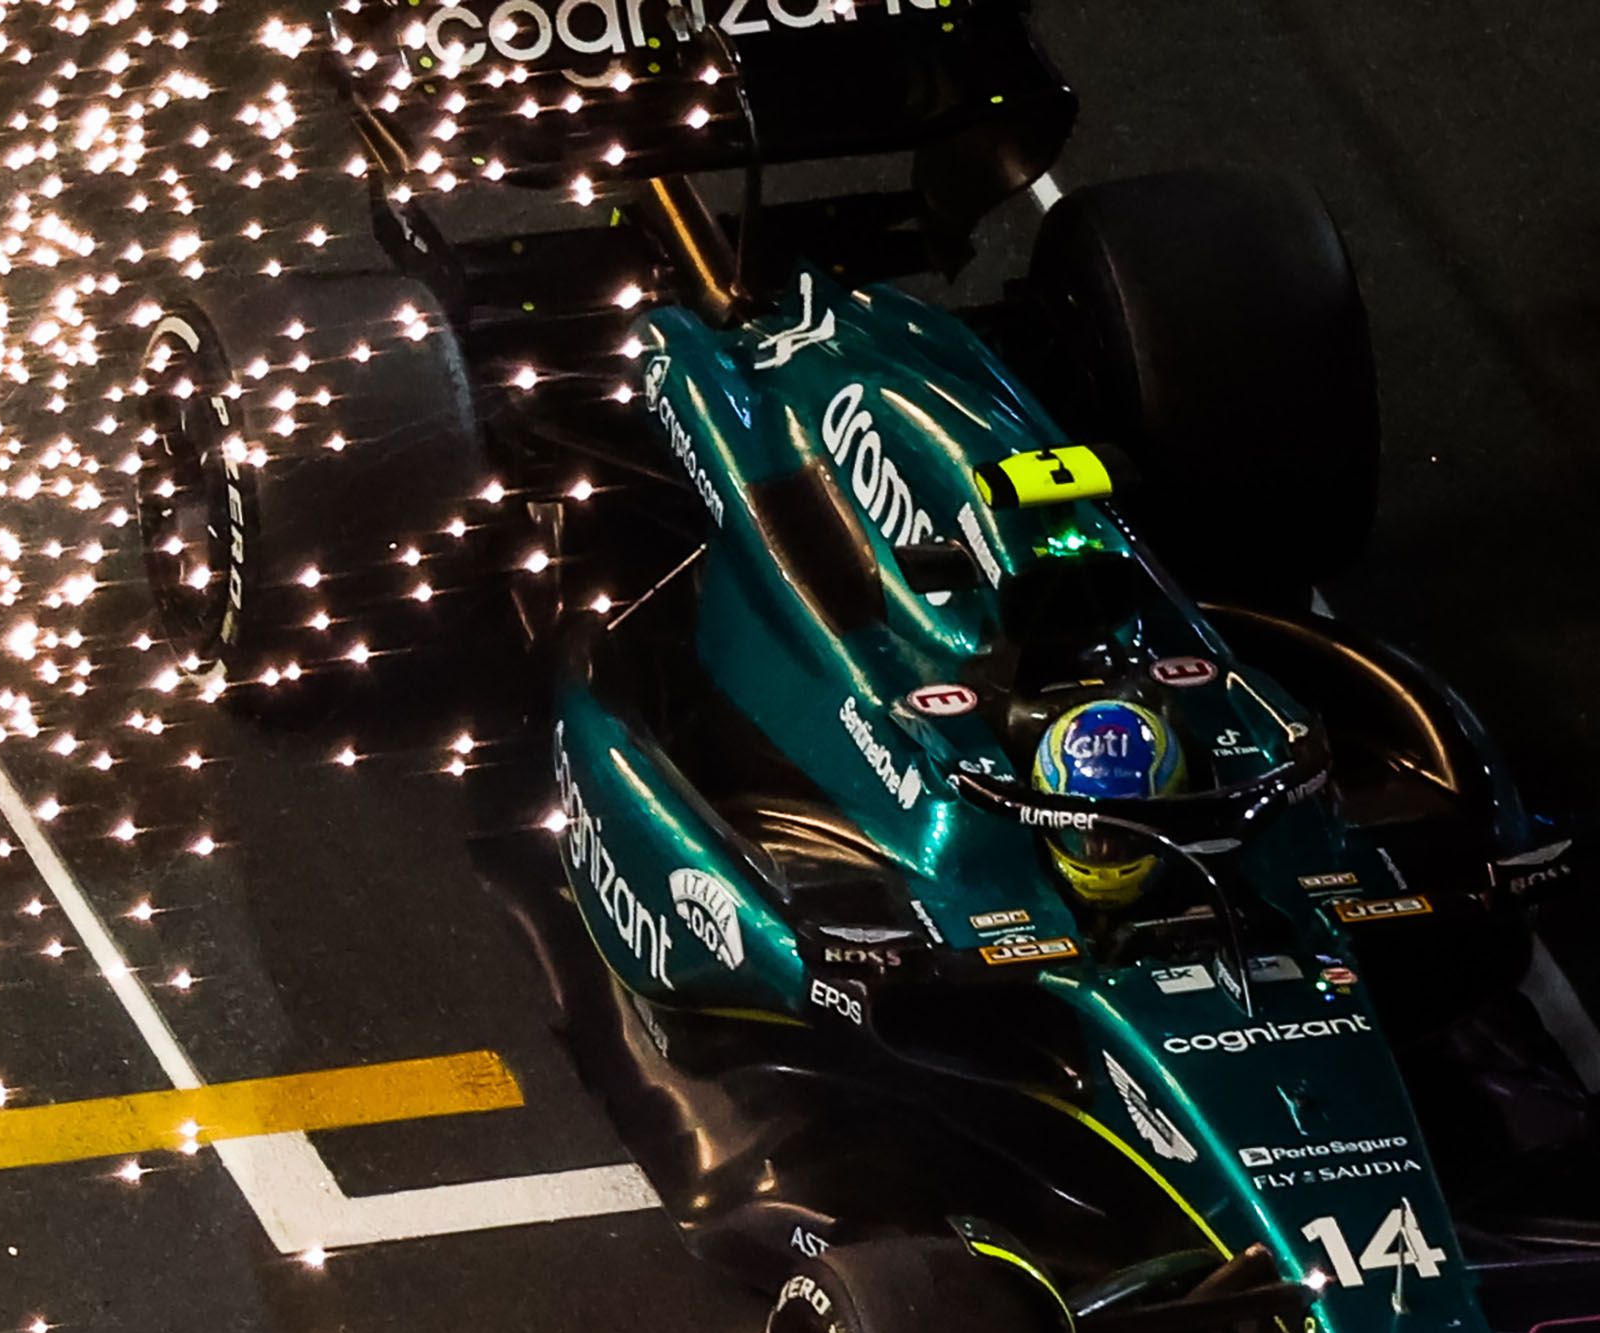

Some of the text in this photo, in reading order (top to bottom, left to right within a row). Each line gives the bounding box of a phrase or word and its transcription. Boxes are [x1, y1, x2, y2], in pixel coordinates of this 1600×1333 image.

[1163, 1012, 1372, 1053] cognizant
[1253, 1159, 1422, 1191] FLY SAUDIA
[1301, 1206, 1448, 1289] 14
